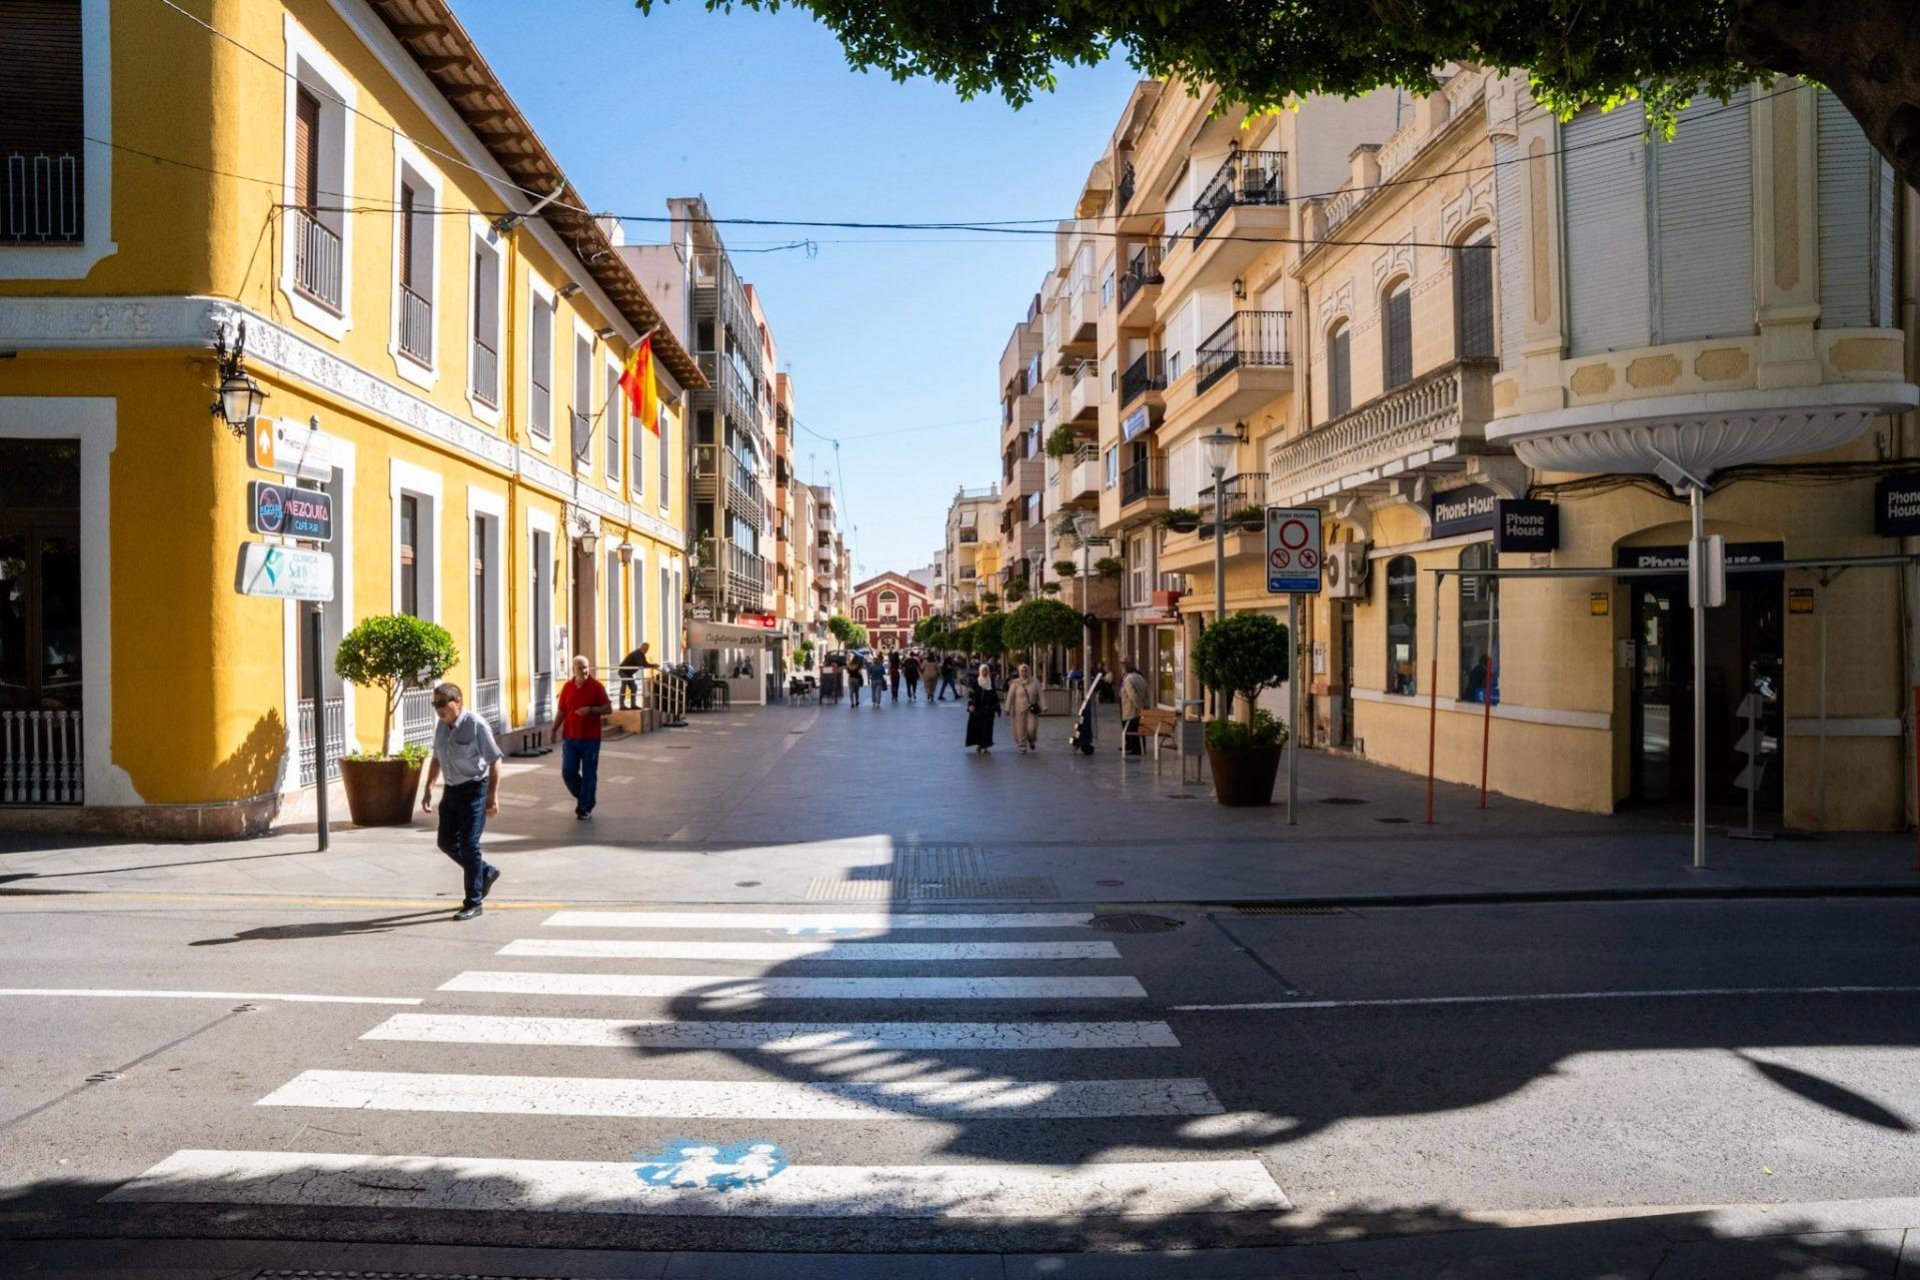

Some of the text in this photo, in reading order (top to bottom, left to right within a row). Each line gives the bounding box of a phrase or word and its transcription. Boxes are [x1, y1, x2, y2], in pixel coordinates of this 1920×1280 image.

[284, 500, 329, 521] MEZQUITA
[1435, 496, 1494, 522] Phone Hous
[1506, 513, 1544, 525] Phone
[1507, 526, 1544, 536] House
[740, 635, 762, 644] mar
